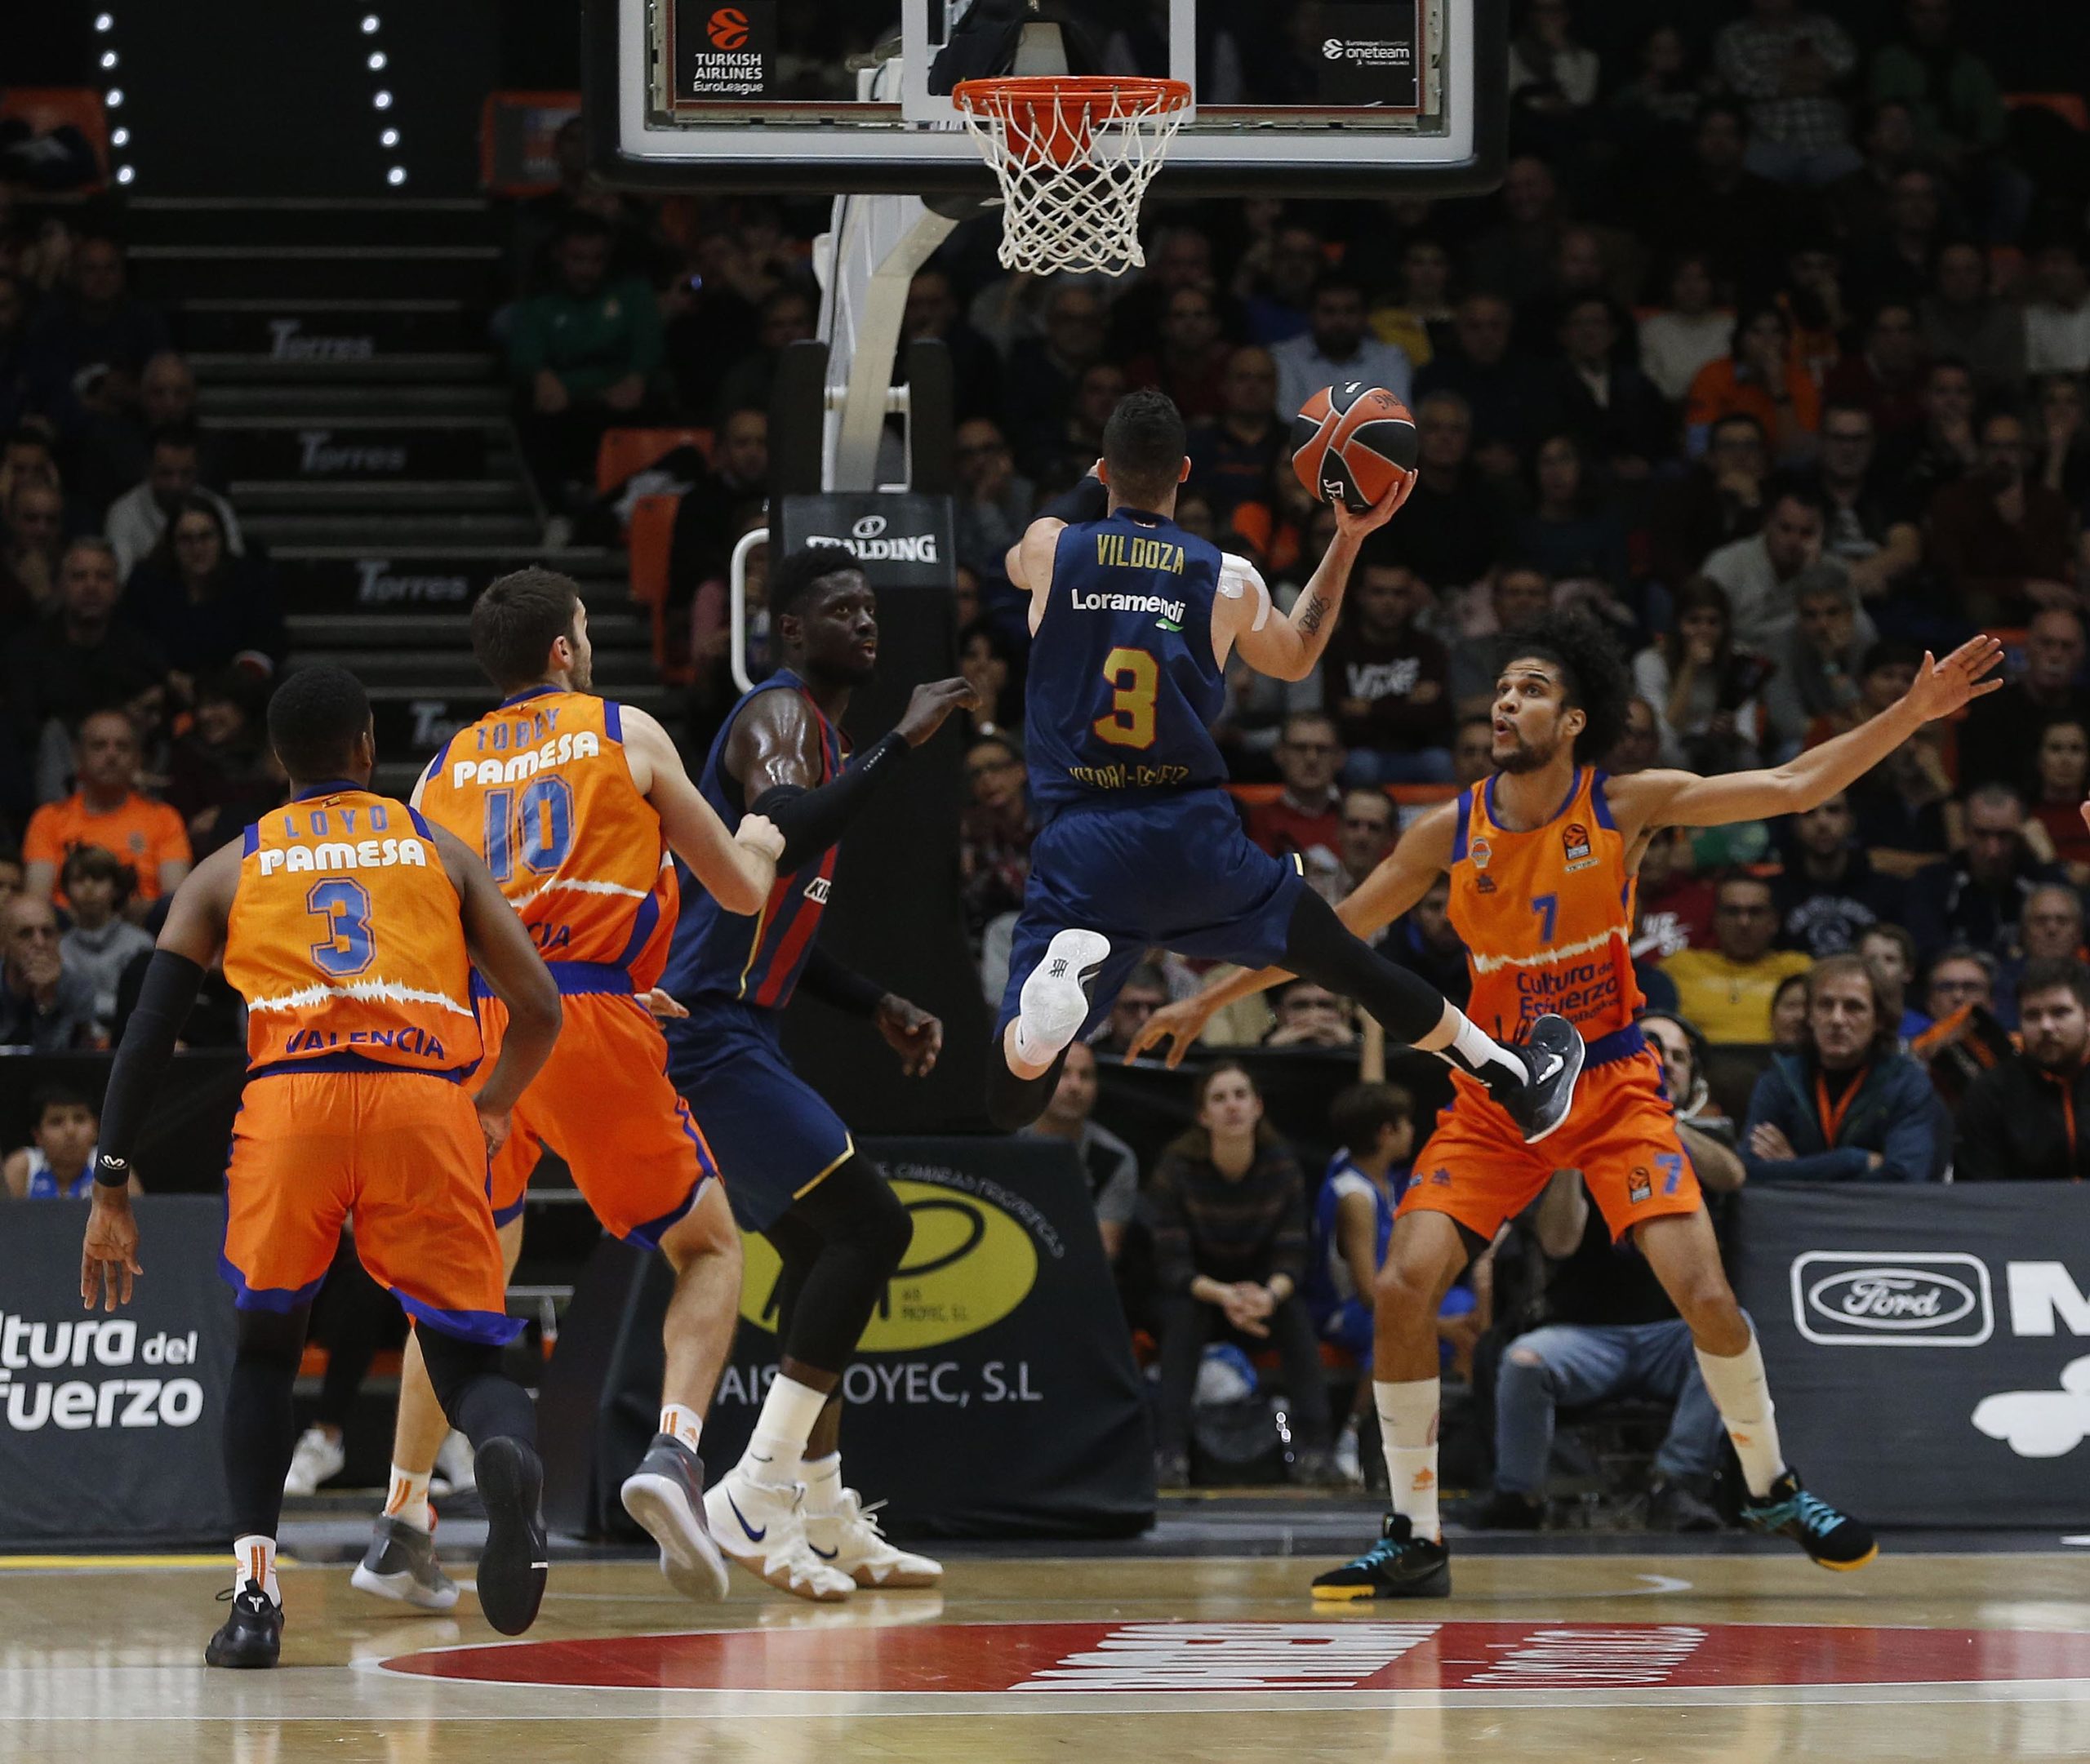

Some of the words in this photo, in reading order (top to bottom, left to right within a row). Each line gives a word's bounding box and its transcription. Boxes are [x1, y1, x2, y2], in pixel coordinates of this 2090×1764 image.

[695, 53, 762, 65] TURKISH
[1345, 47, 1410, 58] oneteam
[693, 81, 764, 95] EuroLeague
[694, 67, 763, 79] AIRLINES
[269, 319, 374, 361] Torres
[299, 431, 407, 473] Torres
[806, 534, 937, 563] LDING
[1097, 534, 1185, 575] VILDOZA
[355, 558, 469, 602] Torres
[1071, 589, 1185, 623] Loramendi
[1092, 647, 1159, 751] 3
[477, 707, 560, 750] TOBEY
[453, 731, 599, 789] PAMESA
[285, 805, 389, 838] LOYD
[483, 774, 575, 882] 10
[259, 838, 426, 876] PAMESA
[305, 877, 376, 978] 3
[1532, 893, 1559, 945] 7
[1517, 964, 1594, 995] Cultura
[1520, 976, 1618, 1020] Esfuerzo
[285, 1027, 445, 1060] VALENCIA
[1654, 1153, 1683, 1195] 7
[1842, 1278, 1941, 1316] Ford
[142, 1331, 198, 1365] del
